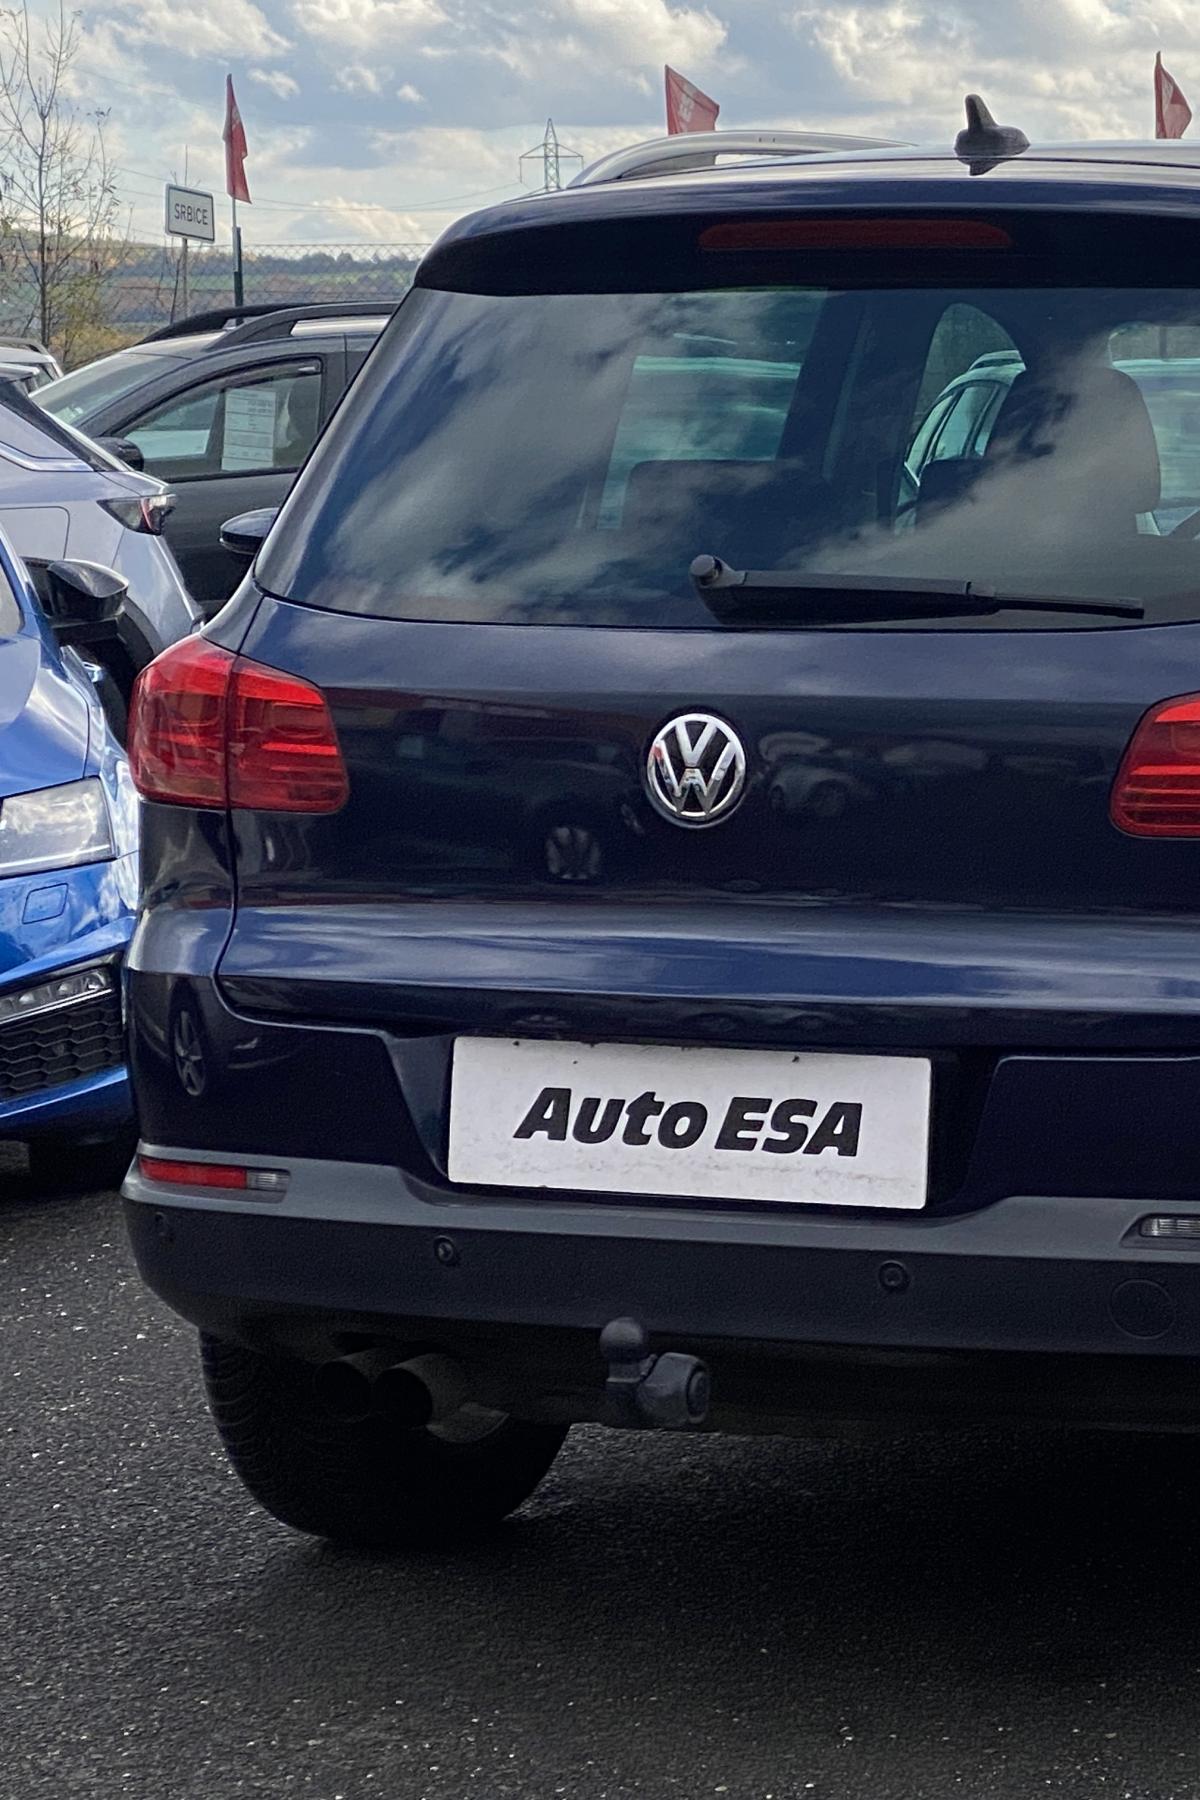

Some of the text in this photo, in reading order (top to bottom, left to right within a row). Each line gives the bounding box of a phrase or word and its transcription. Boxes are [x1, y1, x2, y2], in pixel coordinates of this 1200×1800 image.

[174, 203, 209, 226] SRBICE
[647, 712, 746, 821] VW
[512, 1087, 863, 1157] Auto ESA
